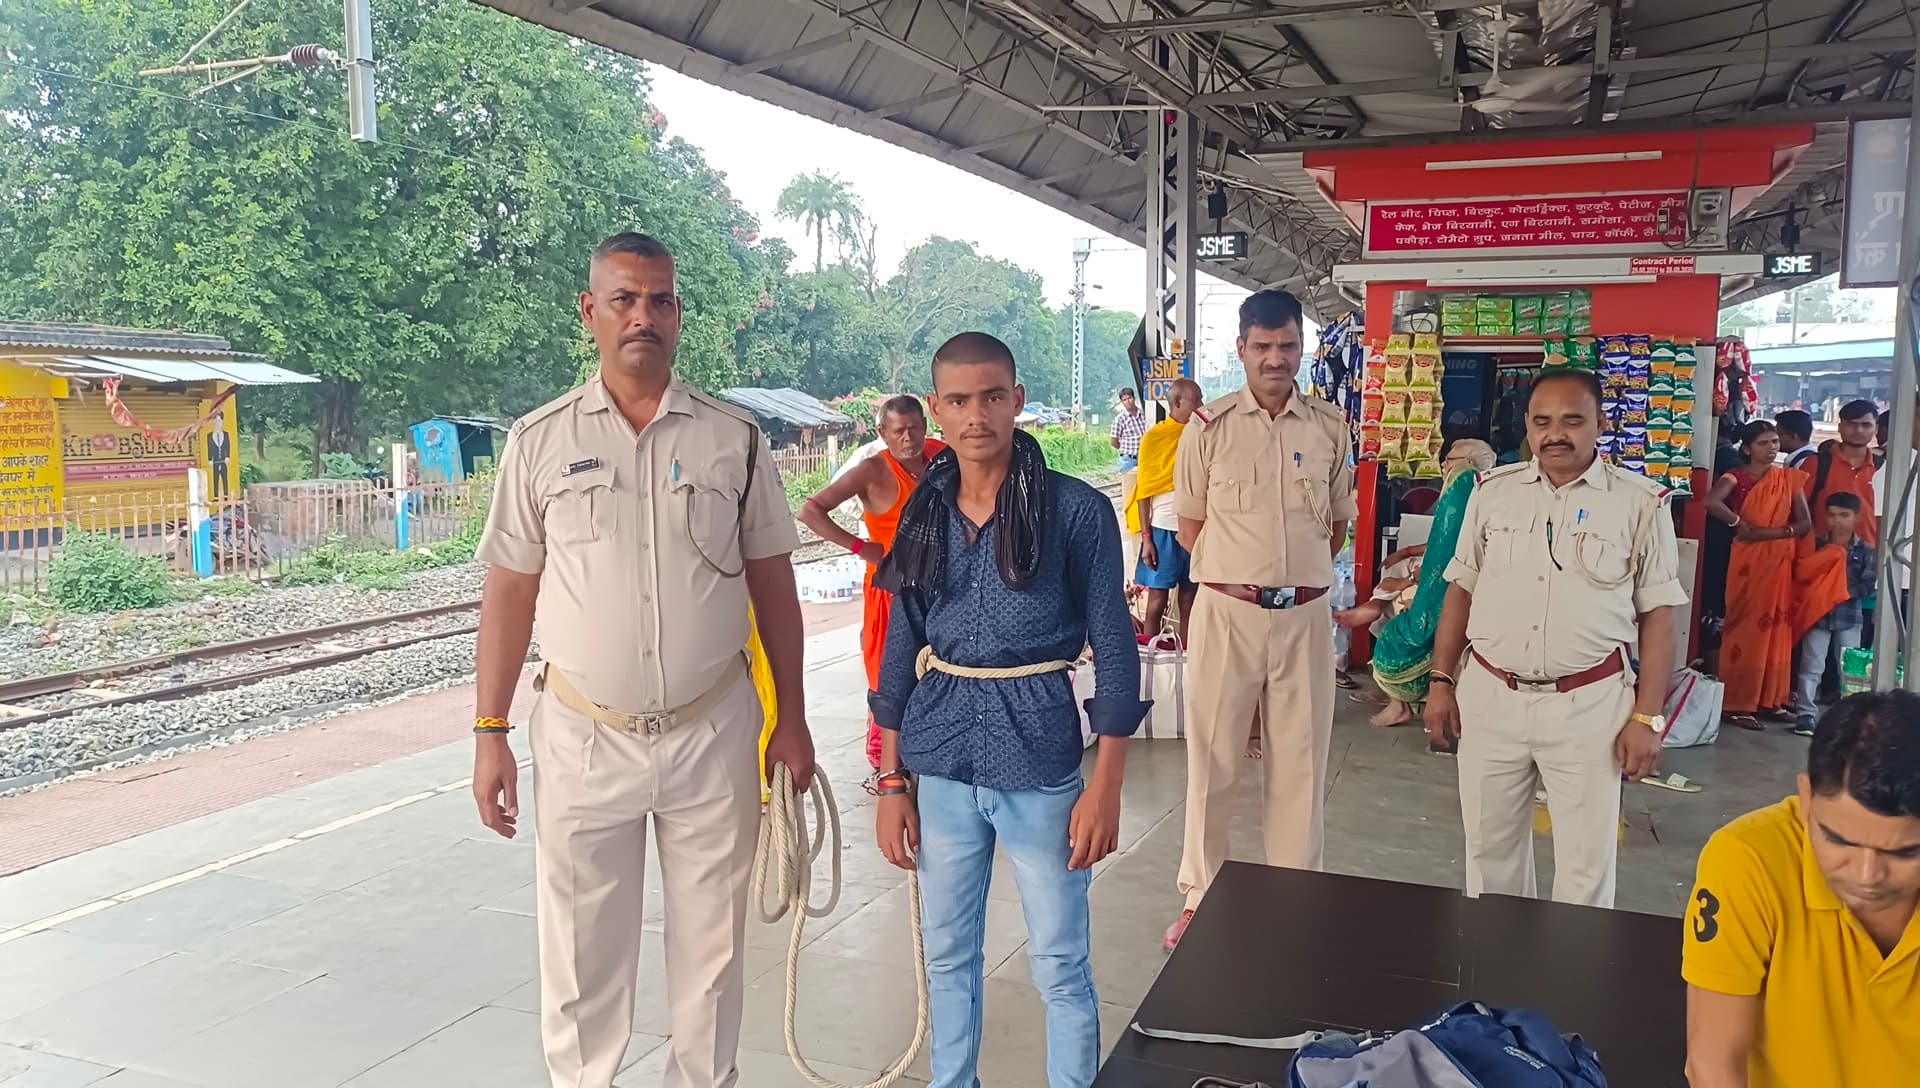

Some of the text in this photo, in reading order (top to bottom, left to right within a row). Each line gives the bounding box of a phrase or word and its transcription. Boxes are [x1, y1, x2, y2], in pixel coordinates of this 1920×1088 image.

[1381, 209, 1398, 219] रेल
[1500, 232, 1536, 241] जनता
[1196, 235, 1235, 256] JSME
[1632, 256, 1694, 265] Contract Period
[1771, 255, 1812, 274] JSME
[1146, 359, 1185, 379] JSME
[2, 453, 28, 467] आपके
[29, 455, 49, 469] शहर
[1693, 888, 1720, 942] 3
